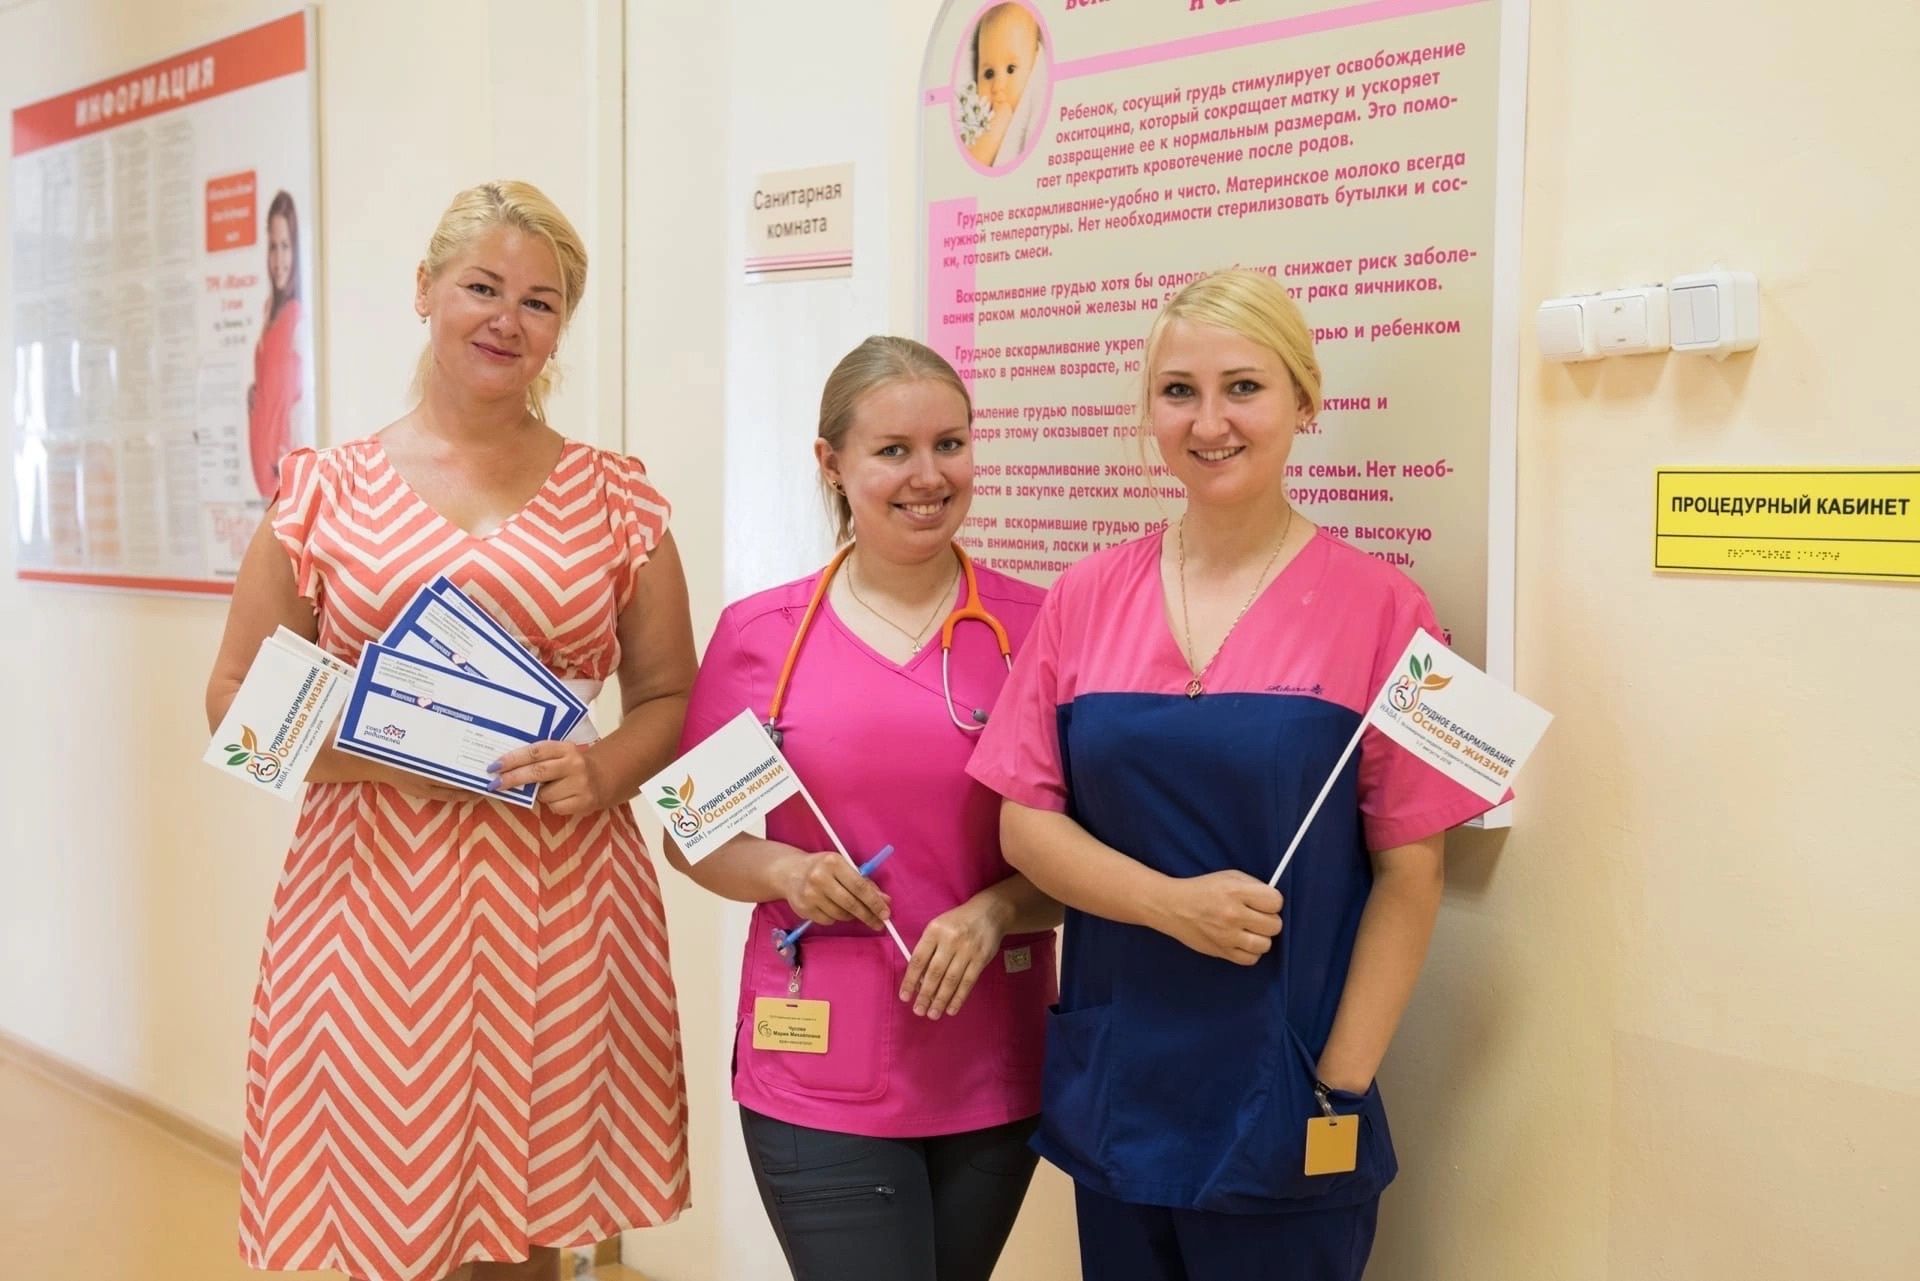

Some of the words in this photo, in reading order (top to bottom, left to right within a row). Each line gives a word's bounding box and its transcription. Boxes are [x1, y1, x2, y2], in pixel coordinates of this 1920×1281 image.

[76, 57, 215, 128] ИНФОРМАЦИЯ
[1060, 103, 1117, 122] Ребенок,
[1122, 88, 1181, 113] сосущий
[1186, 84, 1227, 105] грудь
[1232, 65, 1331, 94] стимулирует
[1336, 42, 1466, 76] освобождение
[1048, 143, 1135, 166] возвращение
[1139, 139, 1155, 153] ее
[1160, 138, 1168, 150] к
[1173, 122, 1269, 150] нормальным
[1275, 109, 1361, 137] размерам.
[1368, 101, 1397, 120] Это
[1403, 96, 1458, 115] помо-
[1056, 122, 1134, 144] окситоцина,
[1139, 110, 1199, 131] который
[1204, 96, 1288, 120] сокращает
[1291, 88, 1340, 107] матку
[1346, 85, 1355, 98] и
[1362, 72, 1440, 101] ускоряет
[1037, 175, 1062, 189] гает
[1066, 164, 1139, 187] прекратить
[1143, 149, 1244, 177] кровотечение
[1249, 142, 1293, 160] после
[1299, 134, 1354, 157] родов.
[754, 184, 842, 208] Санитарная
[944, 233, 987, 251] нужной
[990, 223, 1073, 242] температуры.
[1078, 216, 1101, 232] Нет
[1105, 206, 1212, 229] необходимости
[1217, 193, 1330, 219] стерилизовать
[1335, 184, 1408, 207] бутылки
[1414, 182, 1425, 195] и
[1432, 178, 1468, 193] сос-
[958, 210, 1004, 229] Грудное
[1164, 189, 1173, 201] и
[1178, 184, 1220, 199] чисто.
[1226, 170, 1329, 194] Материнское
[1335, 161, 1400, 181] молоко
[1407, 152, 1466, 172] всегда
[767, 217, 827, 239] комната
[944, 256, 960, 268] ки,
[963, 251, 1011, 265] готовить
[1015, 246, 1052, 260] смеси.
[956, 286, 1047, 306] Вскармливание
[1051, 281, 1097, 299] грудью
[1101, 278, 1130, 292] хотя
[1135, 272, 1153, 289] бы
[1284, 259, 1353, 277] снижает
[1358, 255, 1398, 276] риск
[1404, 246, 1477, 267] заболе-
[943, 313, 974, 325] вания
[978, 309, 1015, 326] раком
[1020, 304, 1082, 319] молочной
[1086, 300, 1137, 315] железы
[1141, 298, 1158, 311] на
[1308, 284, 1349, 303] рака
[1354, 278, 1443, 295] яичников.
[956, 346, 1002, 364] Грудное
[1005, 341, 1100, 360] вскармливание
[1105, 339, 1147, 356] укреп
[1355, 326, 1365, 338] и
[1371, 318, 1461, 343] ребенком
[1000, 368, 1007, 378] в
[1010, 365, 1056, 381] раннем
[1060, 361, 1120, 378] возрасте,
[1005, 428, 1039, 442] этому
[1043, 426, 1109, 438] оказывает
[1023, 406, 1067, 422] грудью
[1072, 404, 1137, 417] повышает
[1377, 397, 1388, 410] и
[1005, 465, 1100, 480] вскармливание
[1308, 465, 1361, 478] семьи.
[1366, 460, 1397, 478] Нет
[1402, 459, 1454, 478] необ-
[1006, 486, 1012, 496] в
[1016, 486, 1065, 501] закупке
[1069, 486, 1119, 500] детских
[1672, 494, 1811, 516] ПРОЦЕДУРНЫЙ
[1817, 498, 1910, 515] КАБИНЕТ
[987, 538, 1048, 553] внимания,
[1053, 540, 1089, 552] ласки
[1093, 542, 1101, 553] и
[1005, 518, 1088, 533] вскормившие
[1092, 520, 1140, 536] грудью
[1355, 526, 1432, 545] высокую
[269, 724, 290, 754] ГРУДНОЕ
[285, 667, 319, 724] ВСКАРМЛИВАНИЕ
[278, 713, 308, 758] Основа
[304, 672, 330, 712] жизни
[1418, 703, 1450, 728] ГРУДНОЕ
[1450, 724, 1516, 768] ВСКАРМЛИВАНИЕ
[1412, 712, 1461, 749] Основа
[1462, 746, 1509, 778] жизни
[698, 792, 727, 815] ГРУДНОЕ
[725, 756, 777, 796] ВСКАРМЛИВАНИЕ
[704, 792, 747, 823] Основа
[747, 765, 784, 794] жизни
[685, 834, 704, 849] WABA
